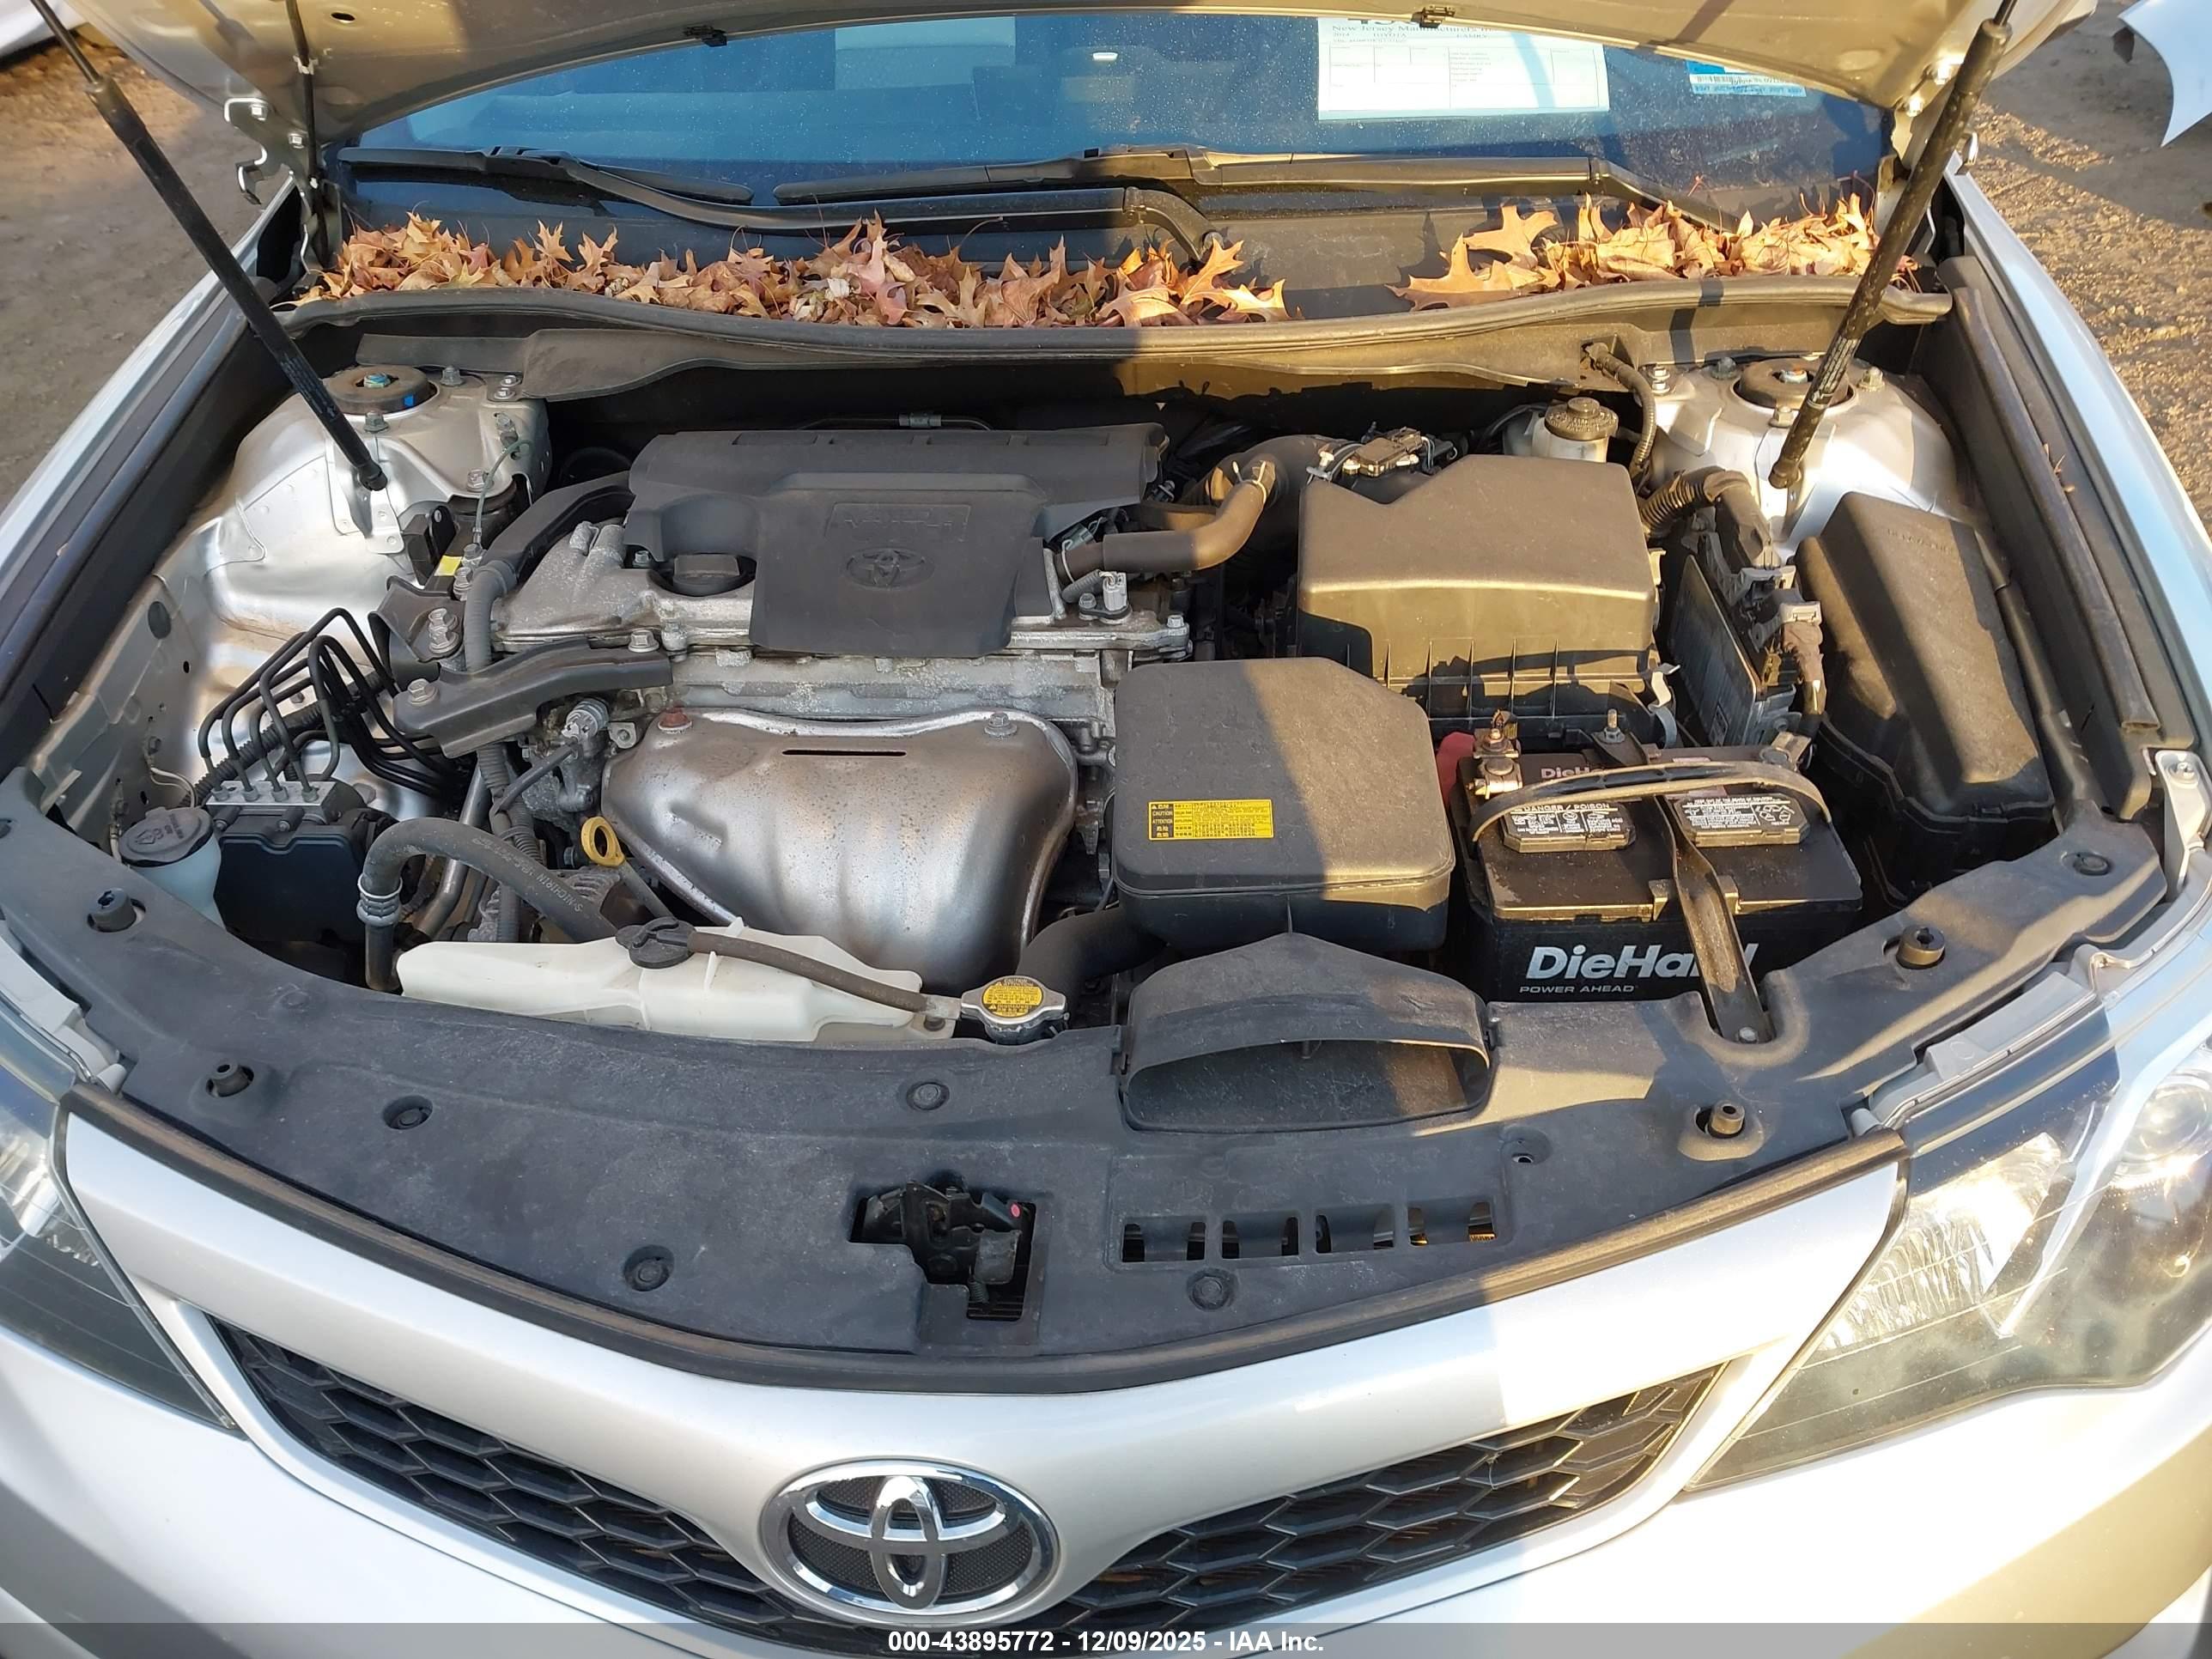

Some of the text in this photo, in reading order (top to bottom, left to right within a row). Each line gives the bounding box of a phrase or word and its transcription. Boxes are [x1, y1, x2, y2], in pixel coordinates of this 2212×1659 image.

[1362, 25, 1395, 33] Jersey
[1523, 804, 1564, 812] DANGER
[1526, 944, 1759, 980] DieHa
[1579, 985, 1634, 994] AHEAD
